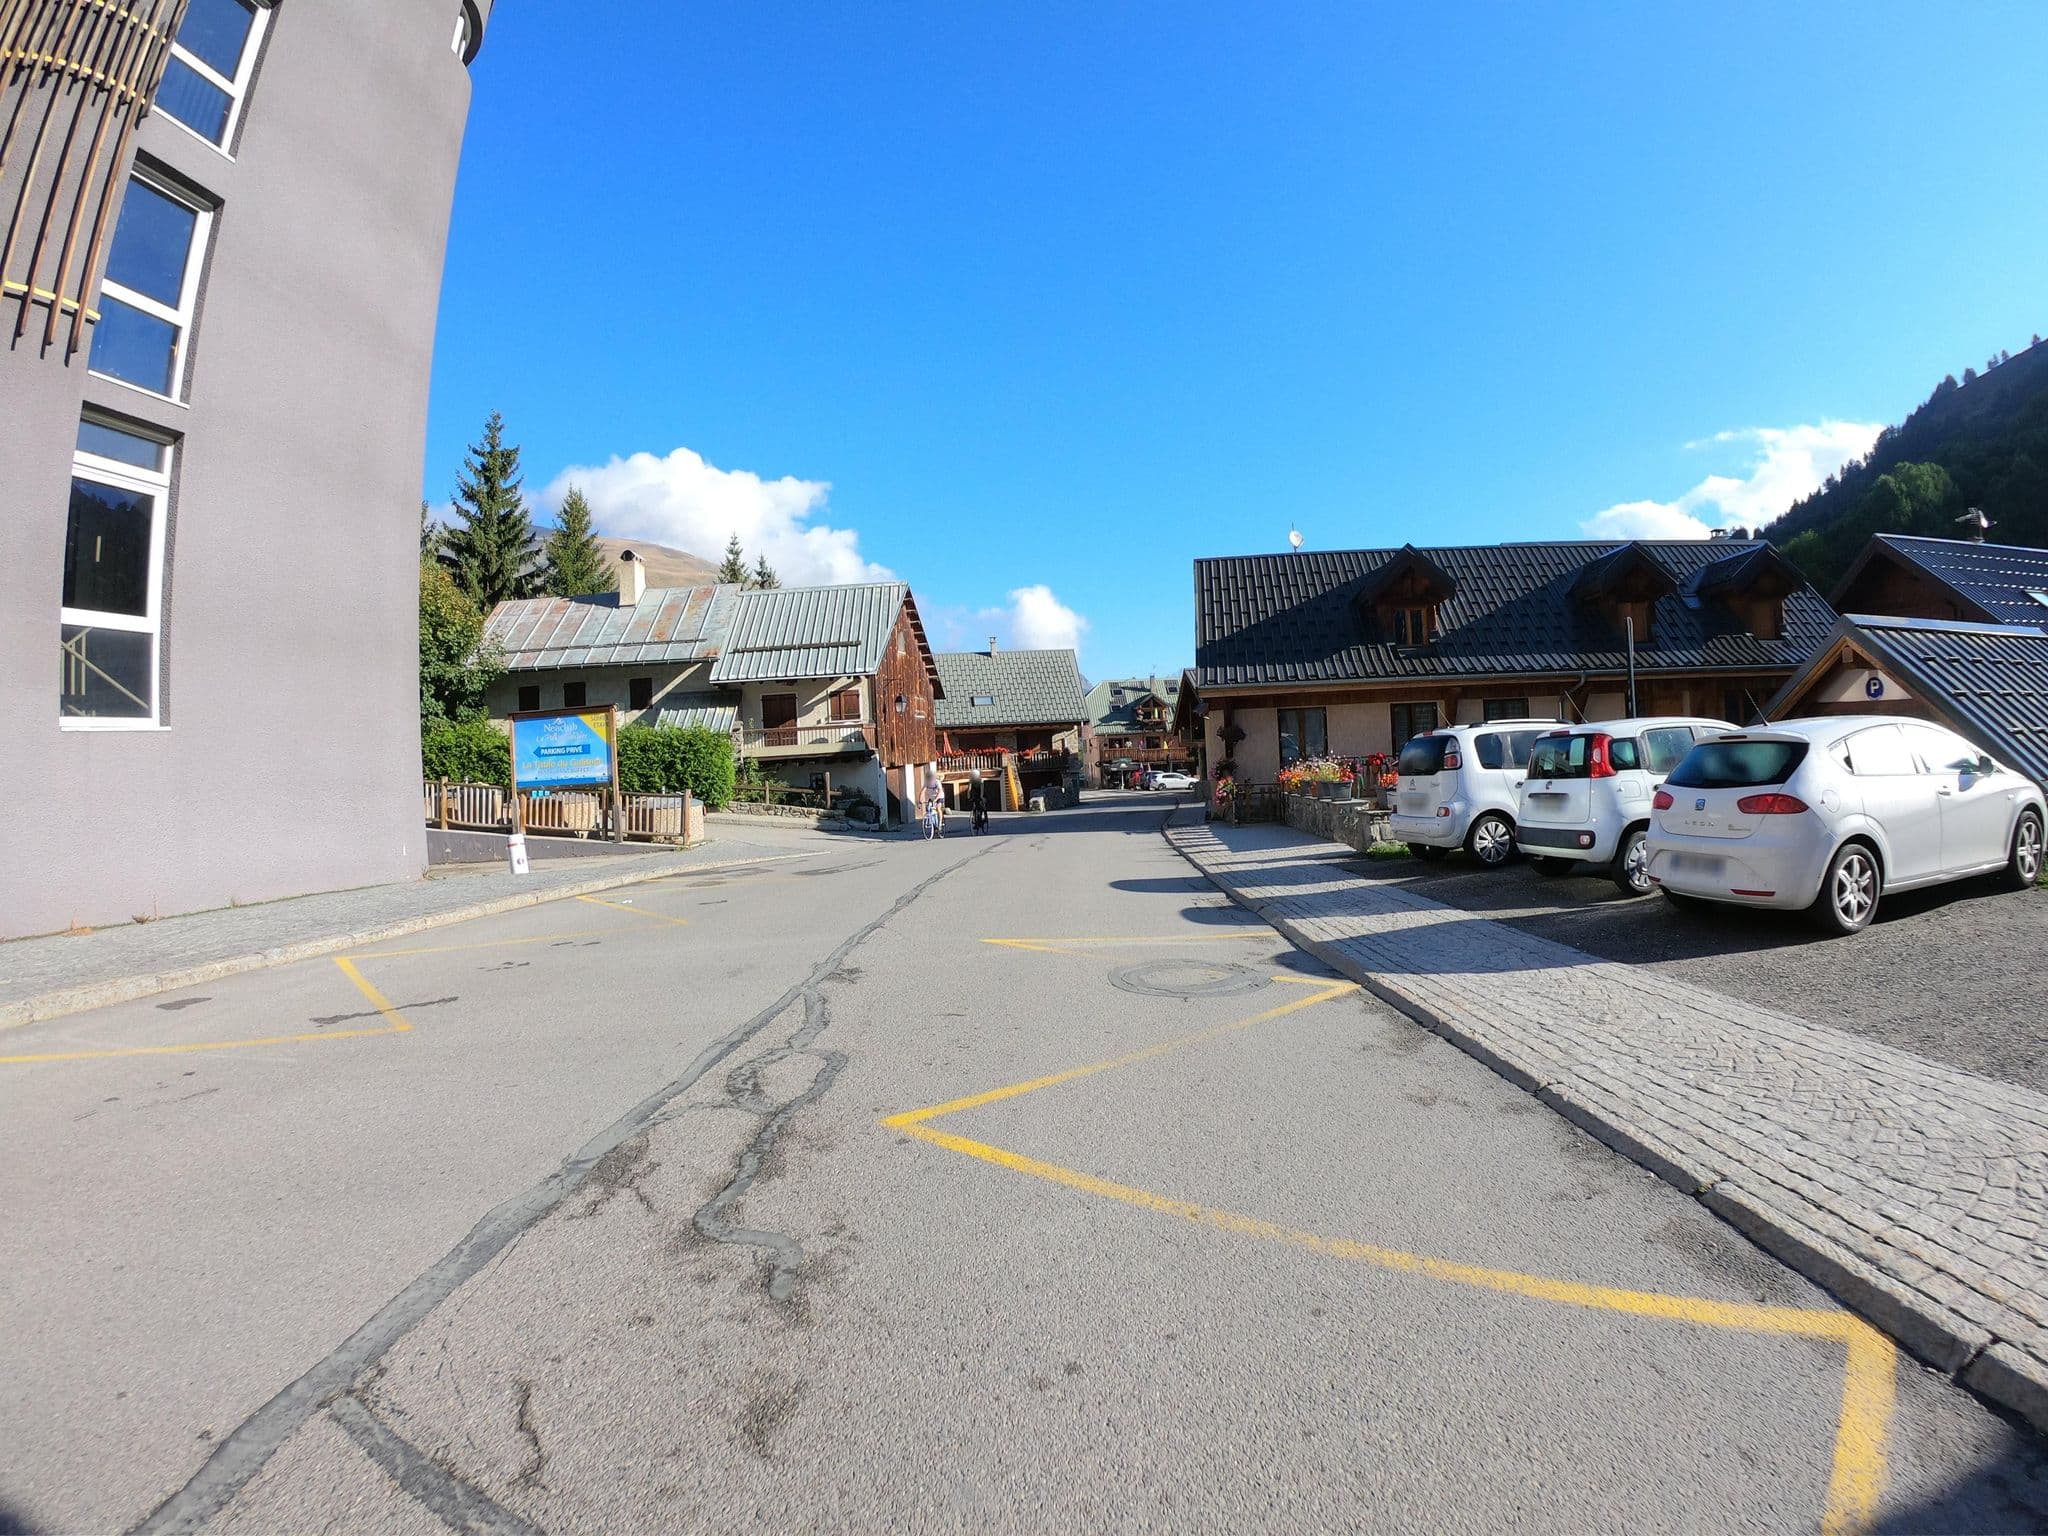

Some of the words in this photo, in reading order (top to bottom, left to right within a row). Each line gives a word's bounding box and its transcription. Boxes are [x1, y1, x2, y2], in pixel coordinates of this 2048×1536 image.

[1870, 679, 1880, 693] P
[541, 747, 565, 755] PARKING
[1684, 819, 1714, 828] LEON
